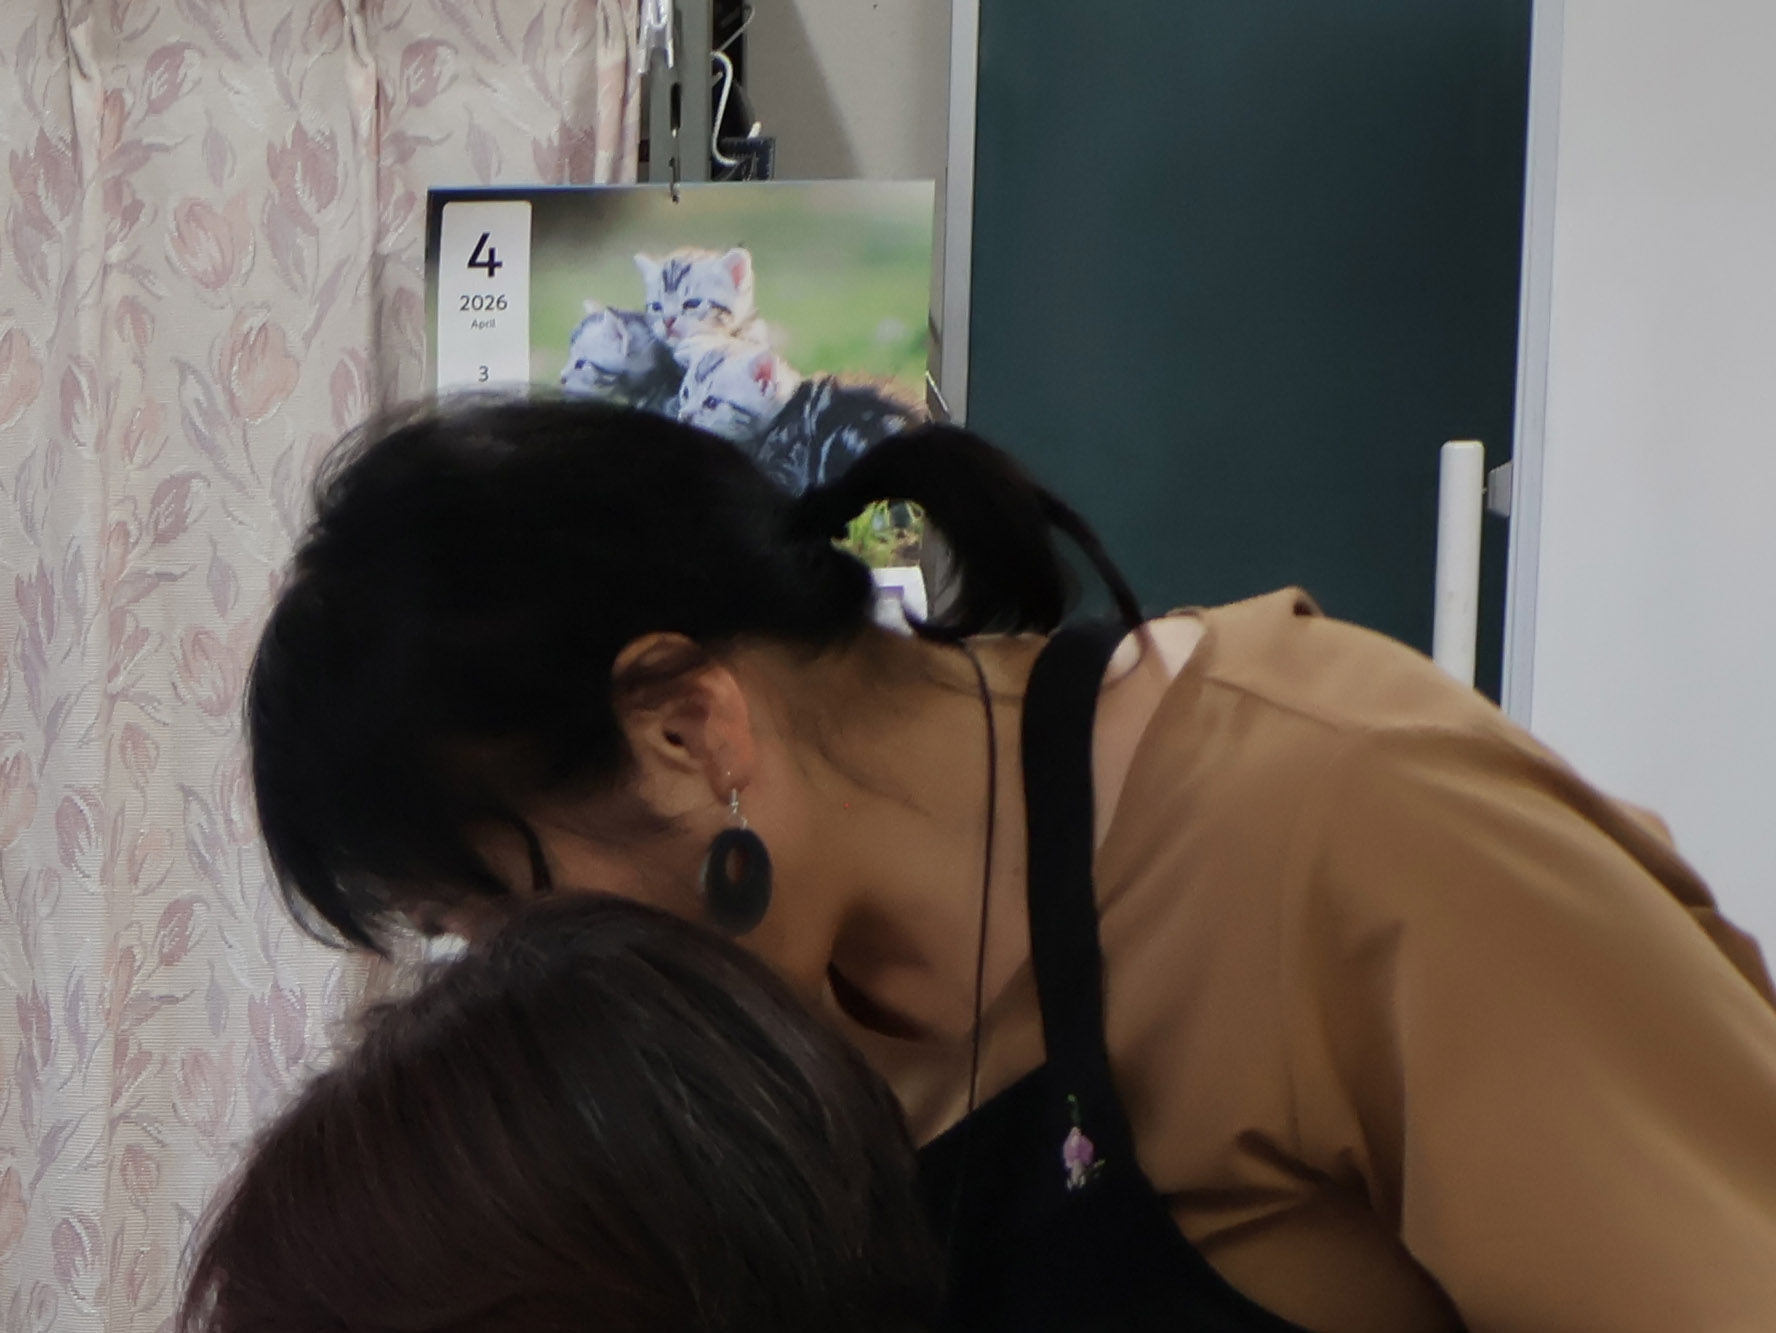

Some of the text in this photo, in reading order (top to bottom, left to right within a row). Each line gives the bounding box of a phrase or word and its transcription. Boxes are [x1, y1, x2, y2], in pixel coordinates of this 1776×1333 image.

[467, 232, 503, 279] 4
[460, 293, 508, 312] 2026
[470, 317, 496, 330] April
[478, 365, 489, 382] 3
